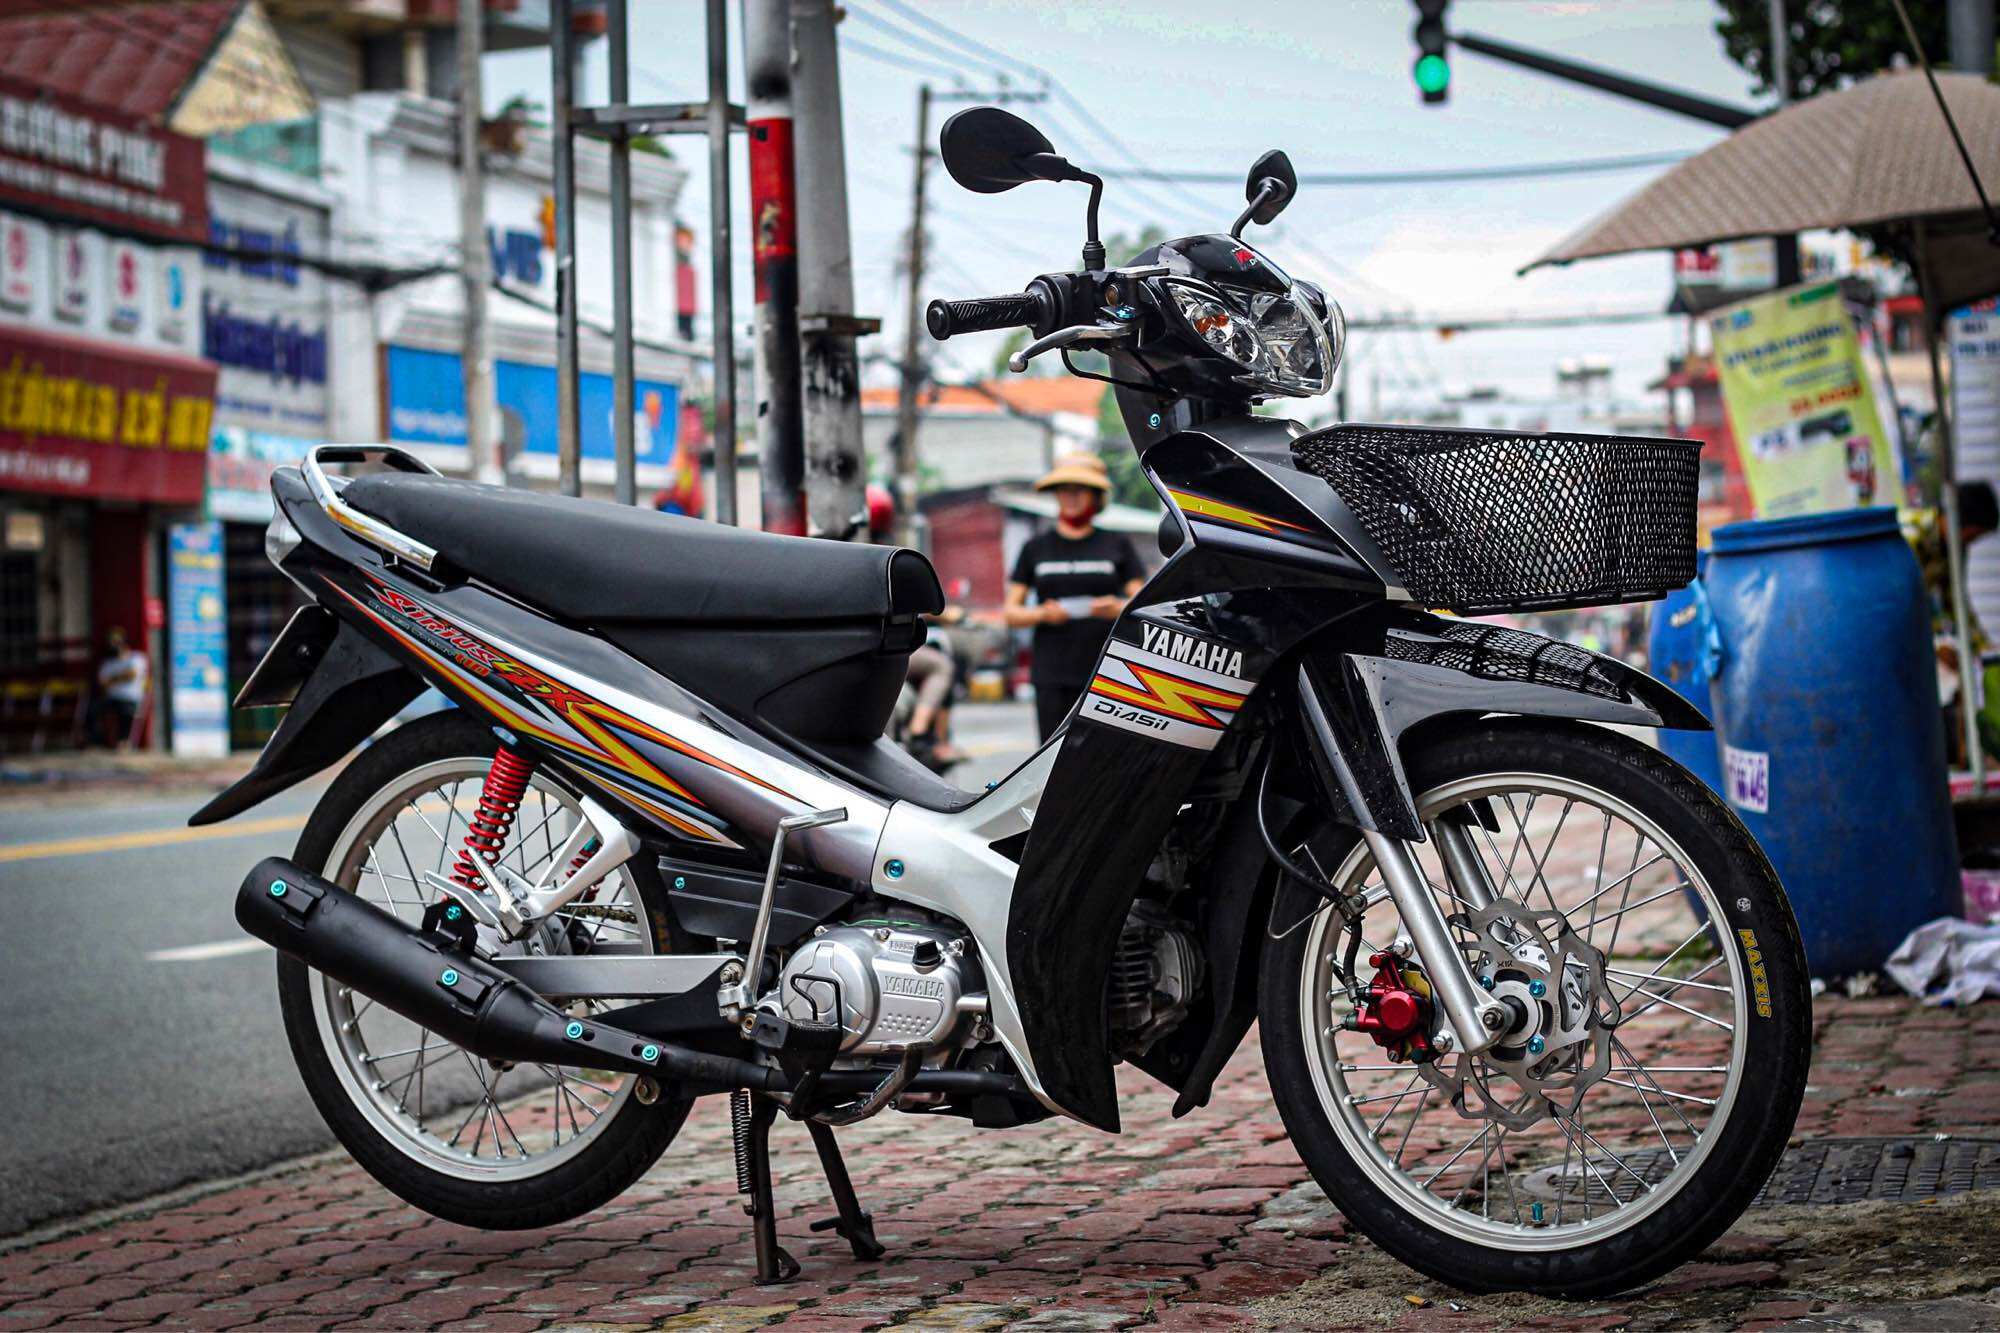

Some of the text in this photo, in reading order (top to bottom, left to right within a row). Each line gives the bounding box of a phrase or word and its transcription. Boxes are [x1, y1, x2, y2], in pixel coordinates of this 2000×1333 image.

[1142, 623, 1243, 679] YAMAHA
[884, 975, 945, 998] YAMAHA
[1738, 928, 1772, 1018] MAXXIS
